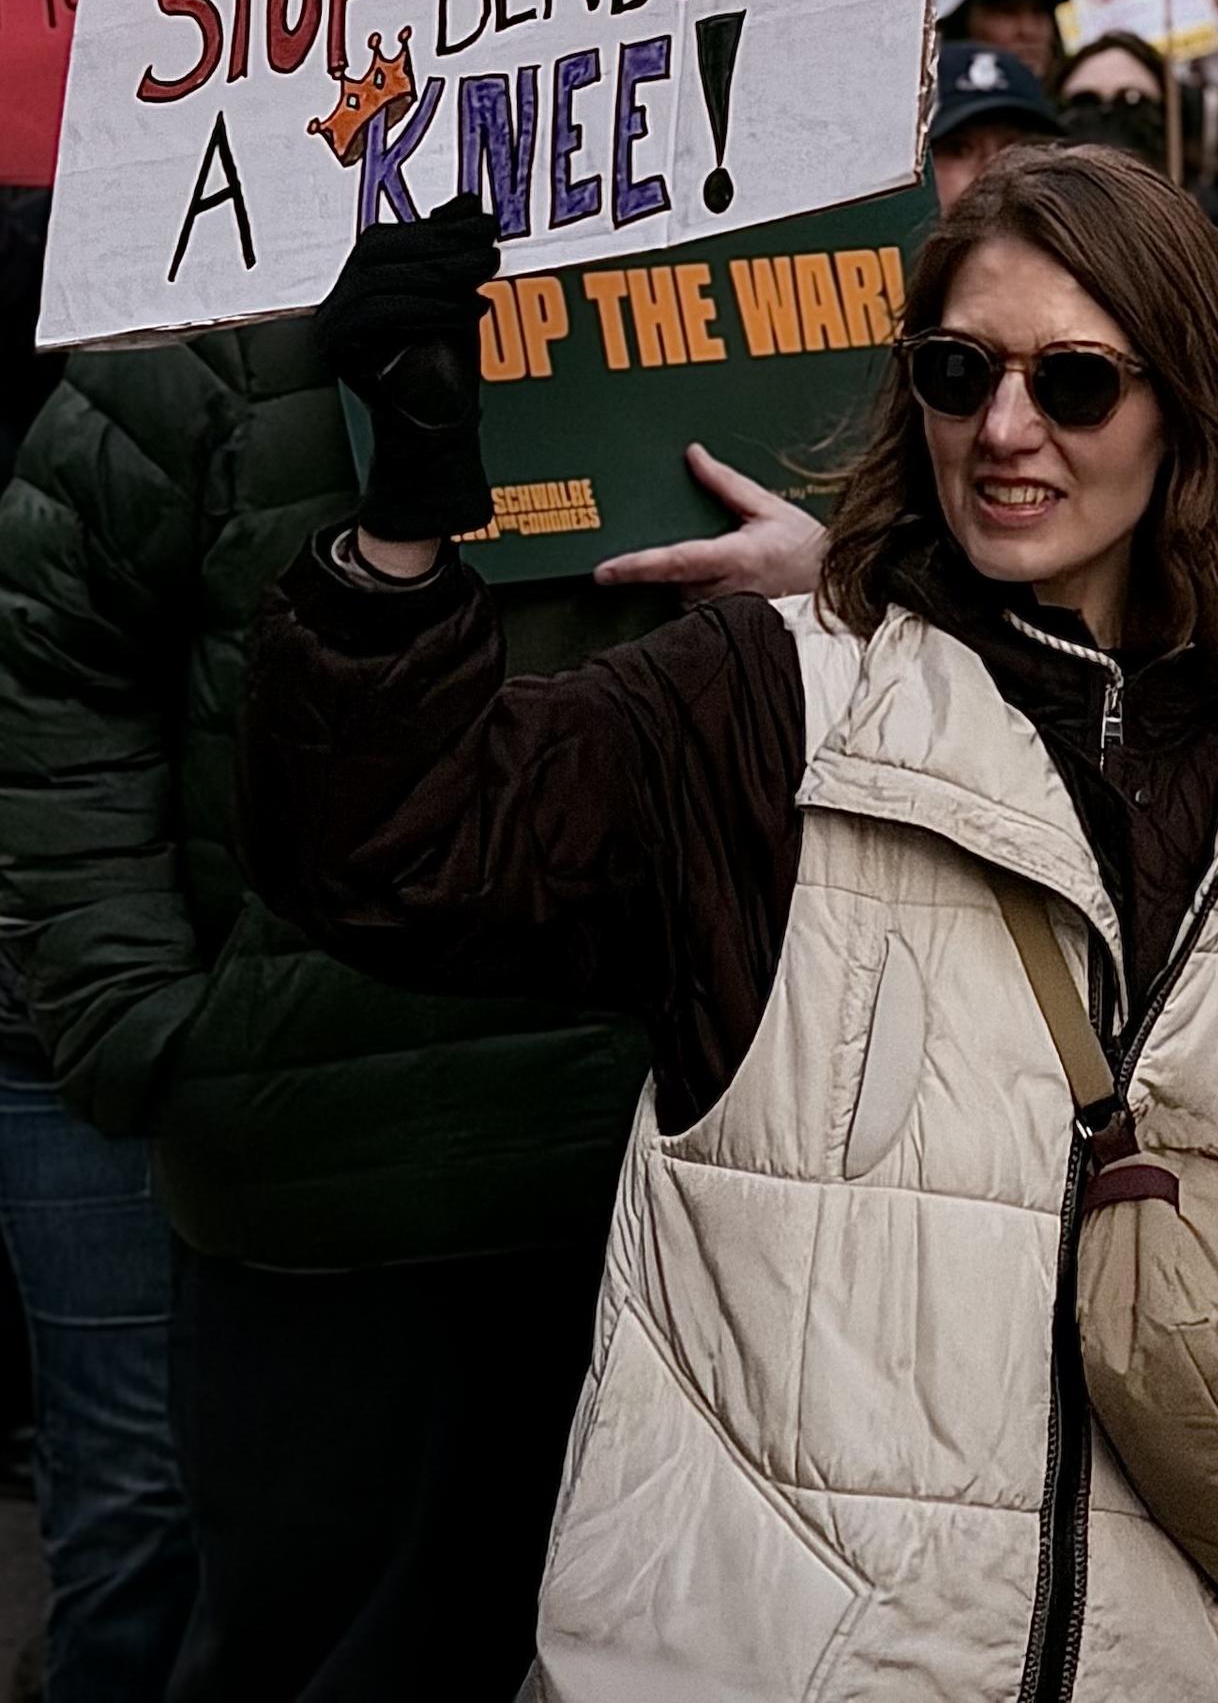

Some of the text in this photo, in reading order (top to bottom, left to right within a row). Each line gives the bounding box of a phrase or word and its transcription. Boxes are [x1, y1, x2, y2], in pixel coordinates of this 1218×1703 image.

[168, 110, 256, 283] A
[476, 246, 906, 382] OP THE WAR!
